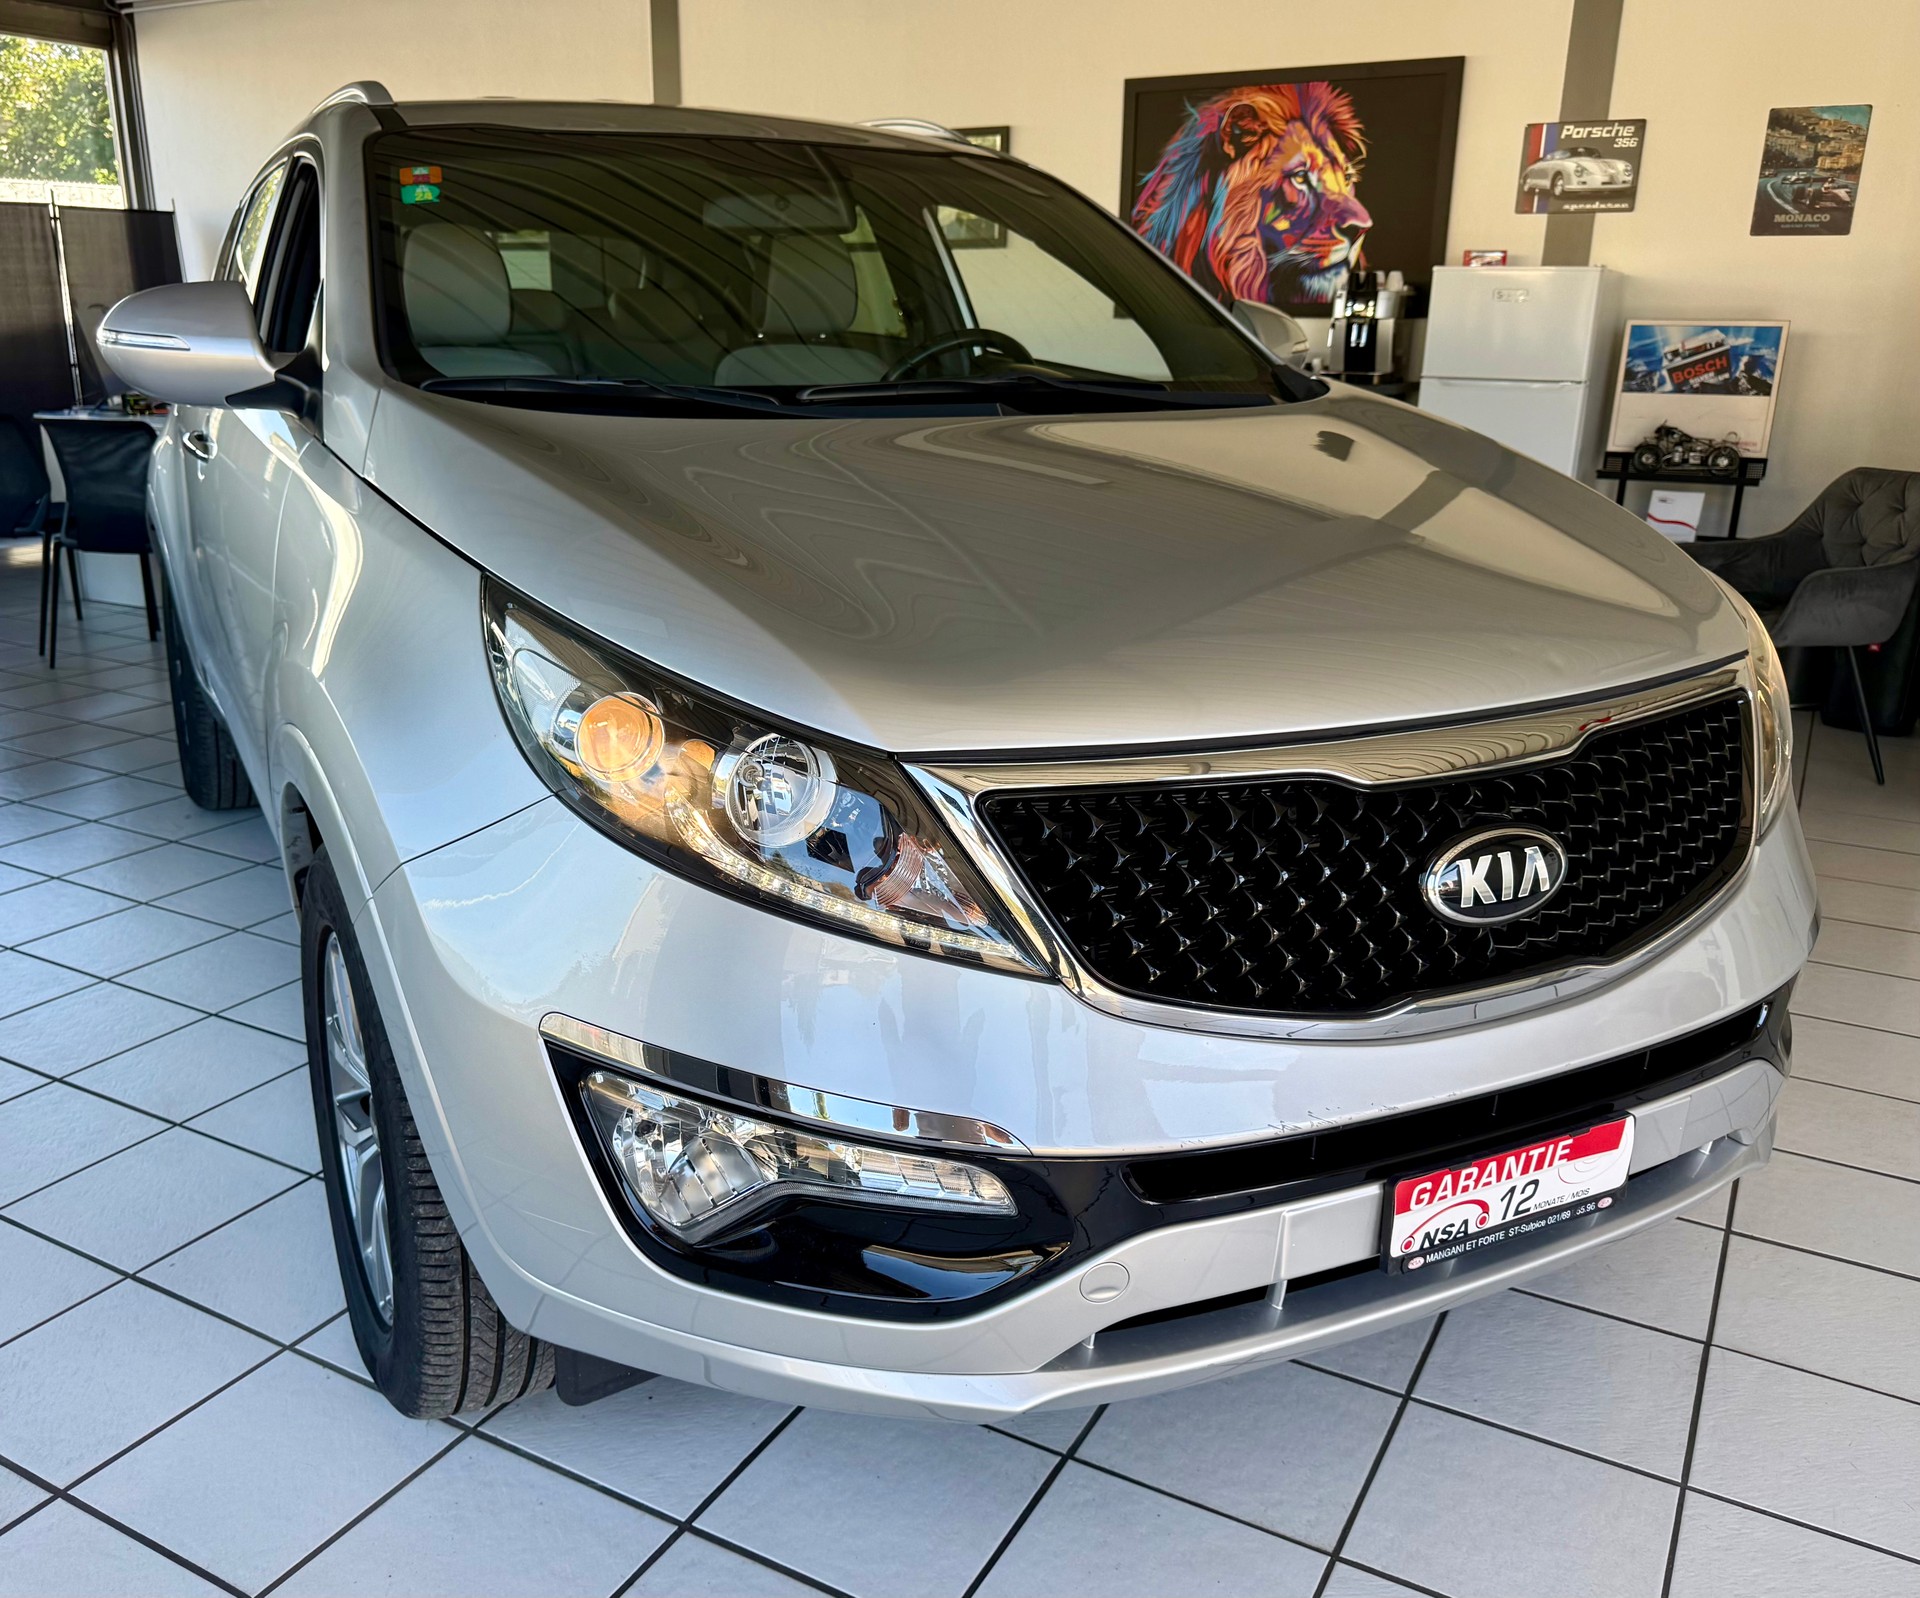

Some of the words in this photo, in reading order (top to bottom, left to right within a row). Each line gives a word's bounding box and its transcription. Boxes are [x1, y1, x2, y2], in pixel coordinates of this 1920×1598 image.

[1560, 122, 1635, 139] Porsche
[1613, 137, 1639, 148] 356
[1773, 213, 1831, 223] MONACO
[1672, 355, 1728, 385] BOSCH
[1455, 846, 1550, 908] KIA
[1409, 1138, 1573, 1212] GARANTIE
[1500, 1178, 1540, 1220] 12
[1533, 1194, 1565, 1211] MONATE
[1571, 1187, 1591, 1200] MOIS
[1419, 1218, 1469, 1250] NSA
[1426, 1243, 1464, 1263] MANGANI
[1466, 1239, 1477, 1251] ET
[1478, 1230, 1505, 1247] FORTE
[1508, 1218, 1546, 1237] ST-Sulpice
